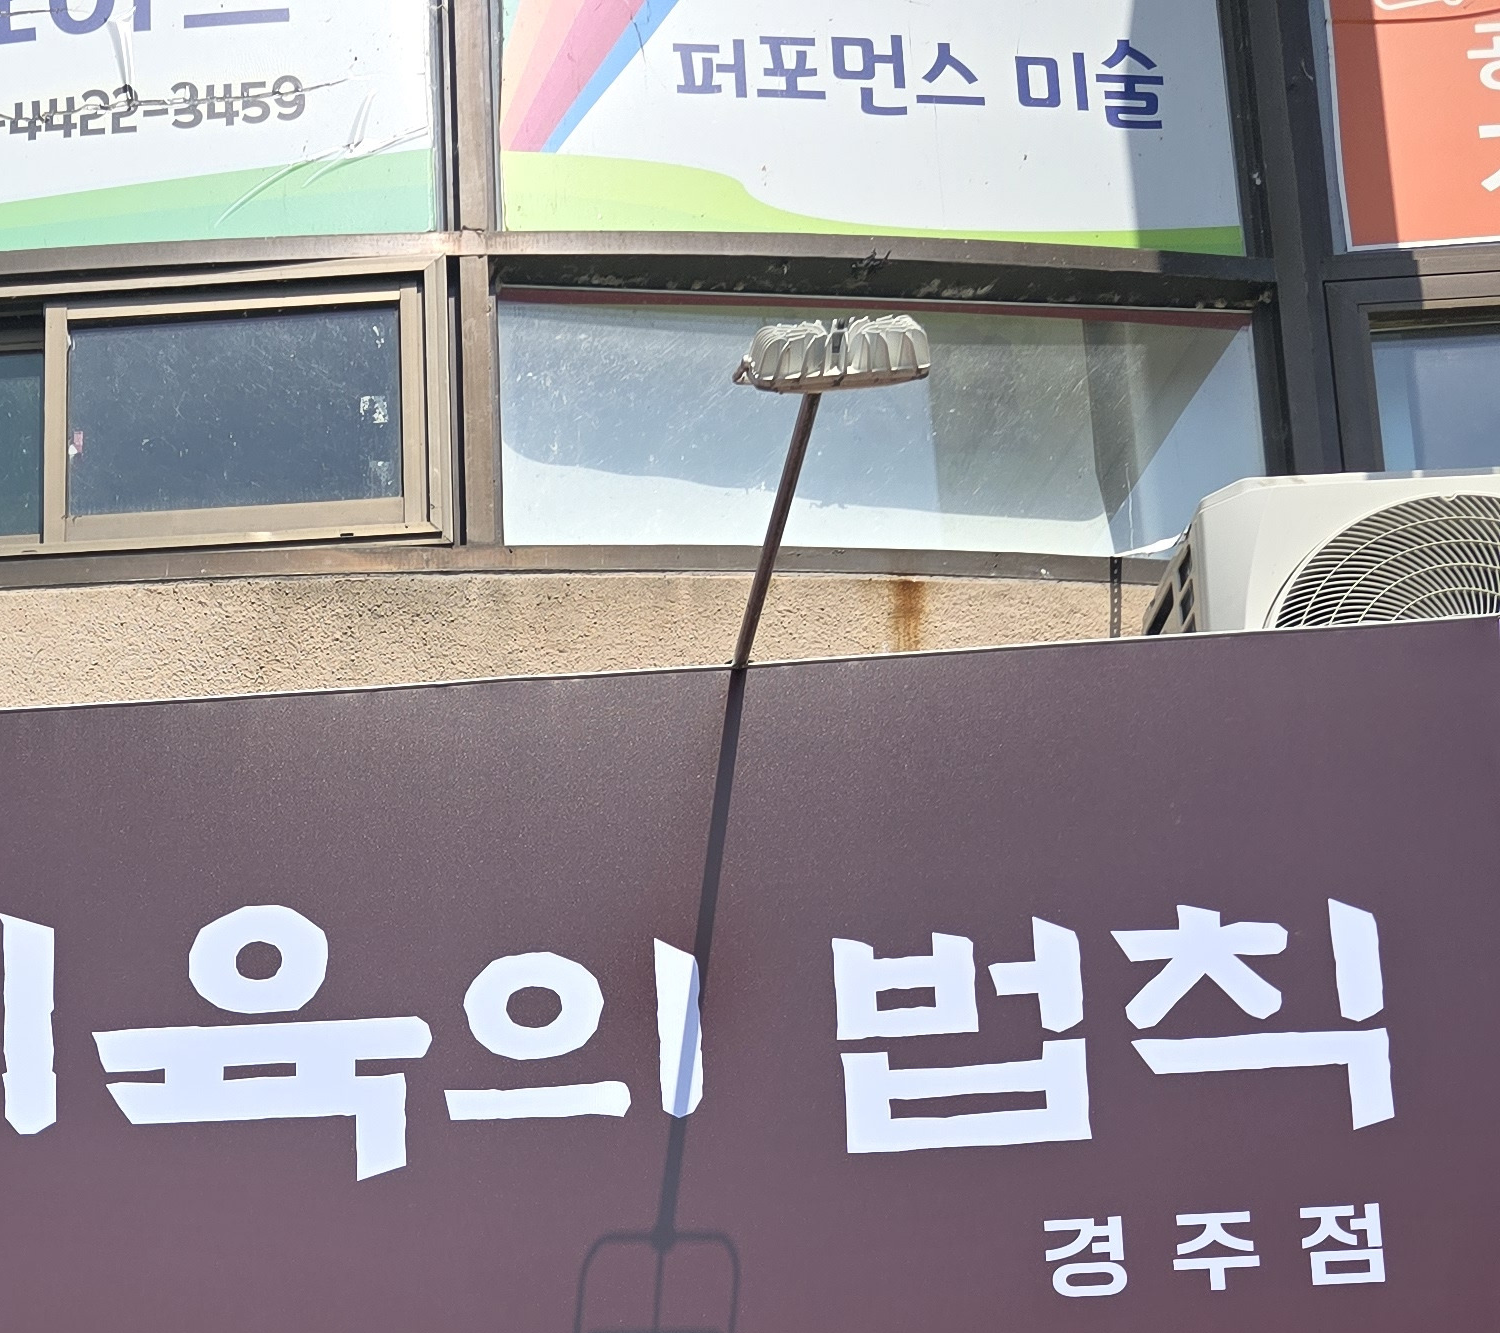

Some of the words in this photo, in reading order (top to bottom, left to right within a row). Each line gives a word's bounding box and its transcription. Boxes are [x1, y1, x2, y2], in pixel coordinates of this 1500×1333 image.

[673, 34, 986, 116] 퍼포먼스
[1015, 39, 1165, 130] 미술
[831, 897, 1395, 1154] 법칙
